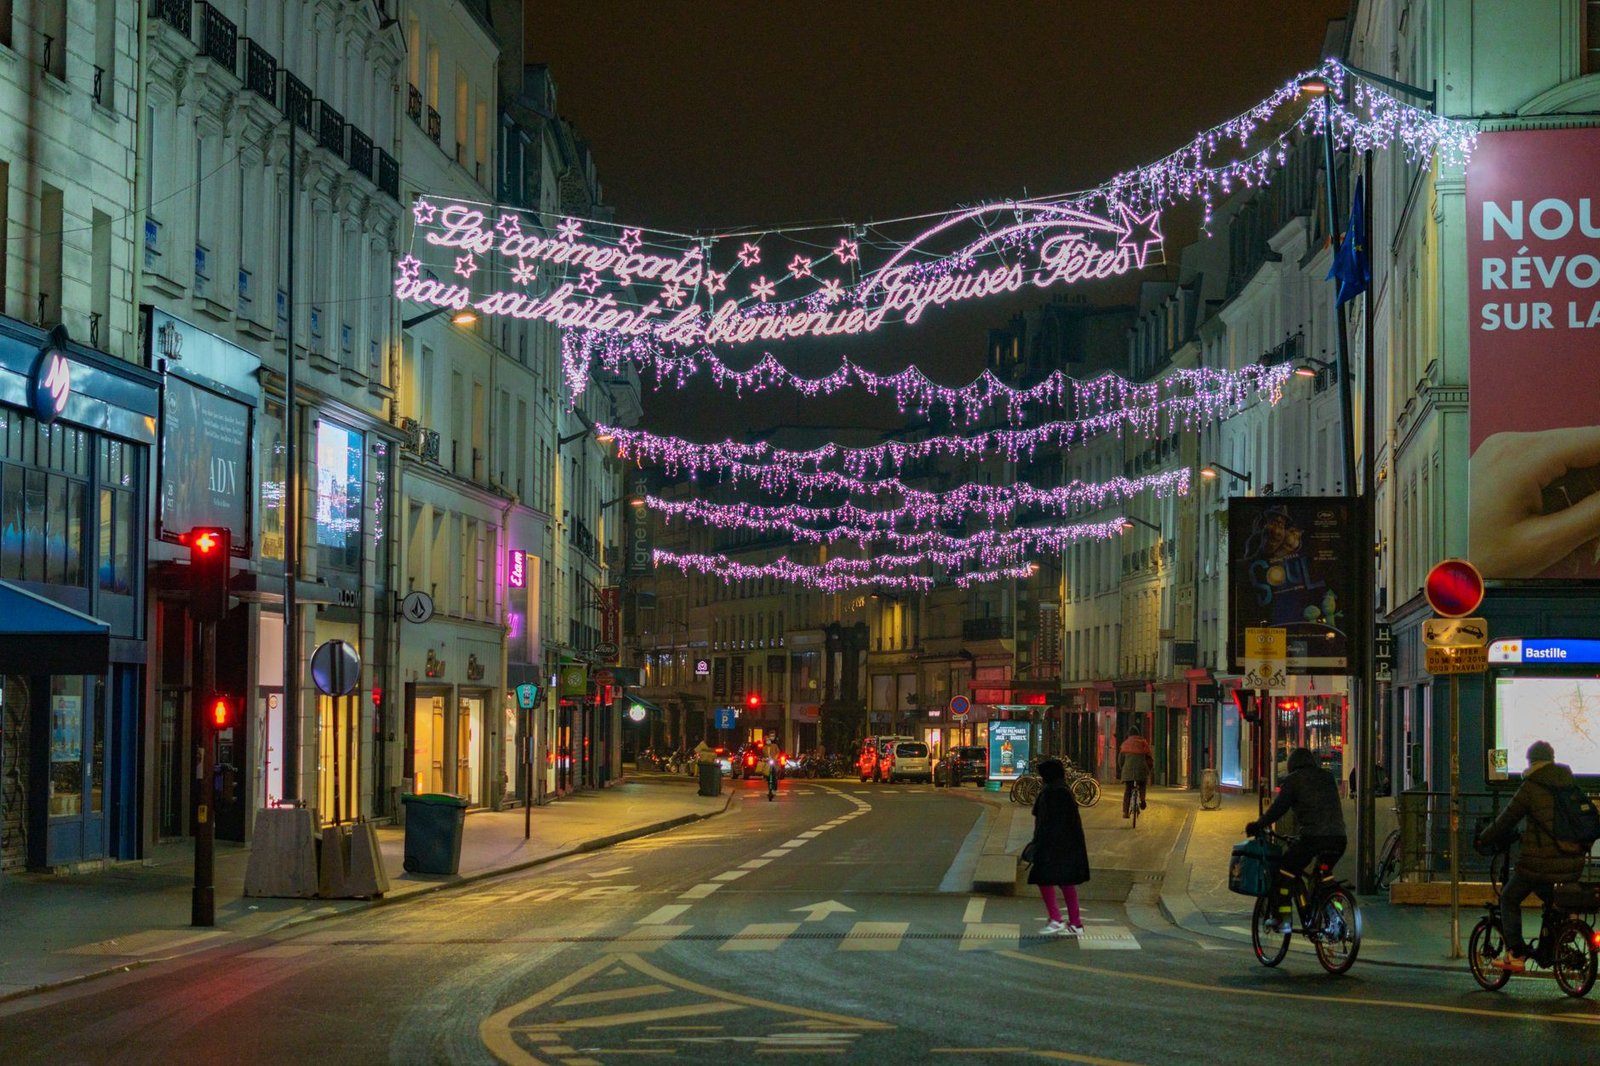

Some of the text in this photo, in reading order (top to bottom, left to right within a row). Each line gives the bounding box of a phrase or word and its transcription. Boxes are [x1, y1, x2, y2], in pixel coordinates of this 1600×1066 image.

[1482, 198, 1600, 241] NOU
[427, 205, 703, 287] Les commerçants
[1481, 245, 1600, 290] RÉVO
[865, 233, 1130, 332] Joyeuses Fêtes
[395, 275, 469, 310] vous
[474, 283, 661, 335] souhaitent
[705, 300, 863, 343] bienvenue
[1480, 301, 1600, 331] SUR LA
[207, 455, 237, 497] ADN
[634, 477, 648, 525] roet
[631, 527, 651, 572] ligne
[1525, 647, 1567, 659] Bastille
